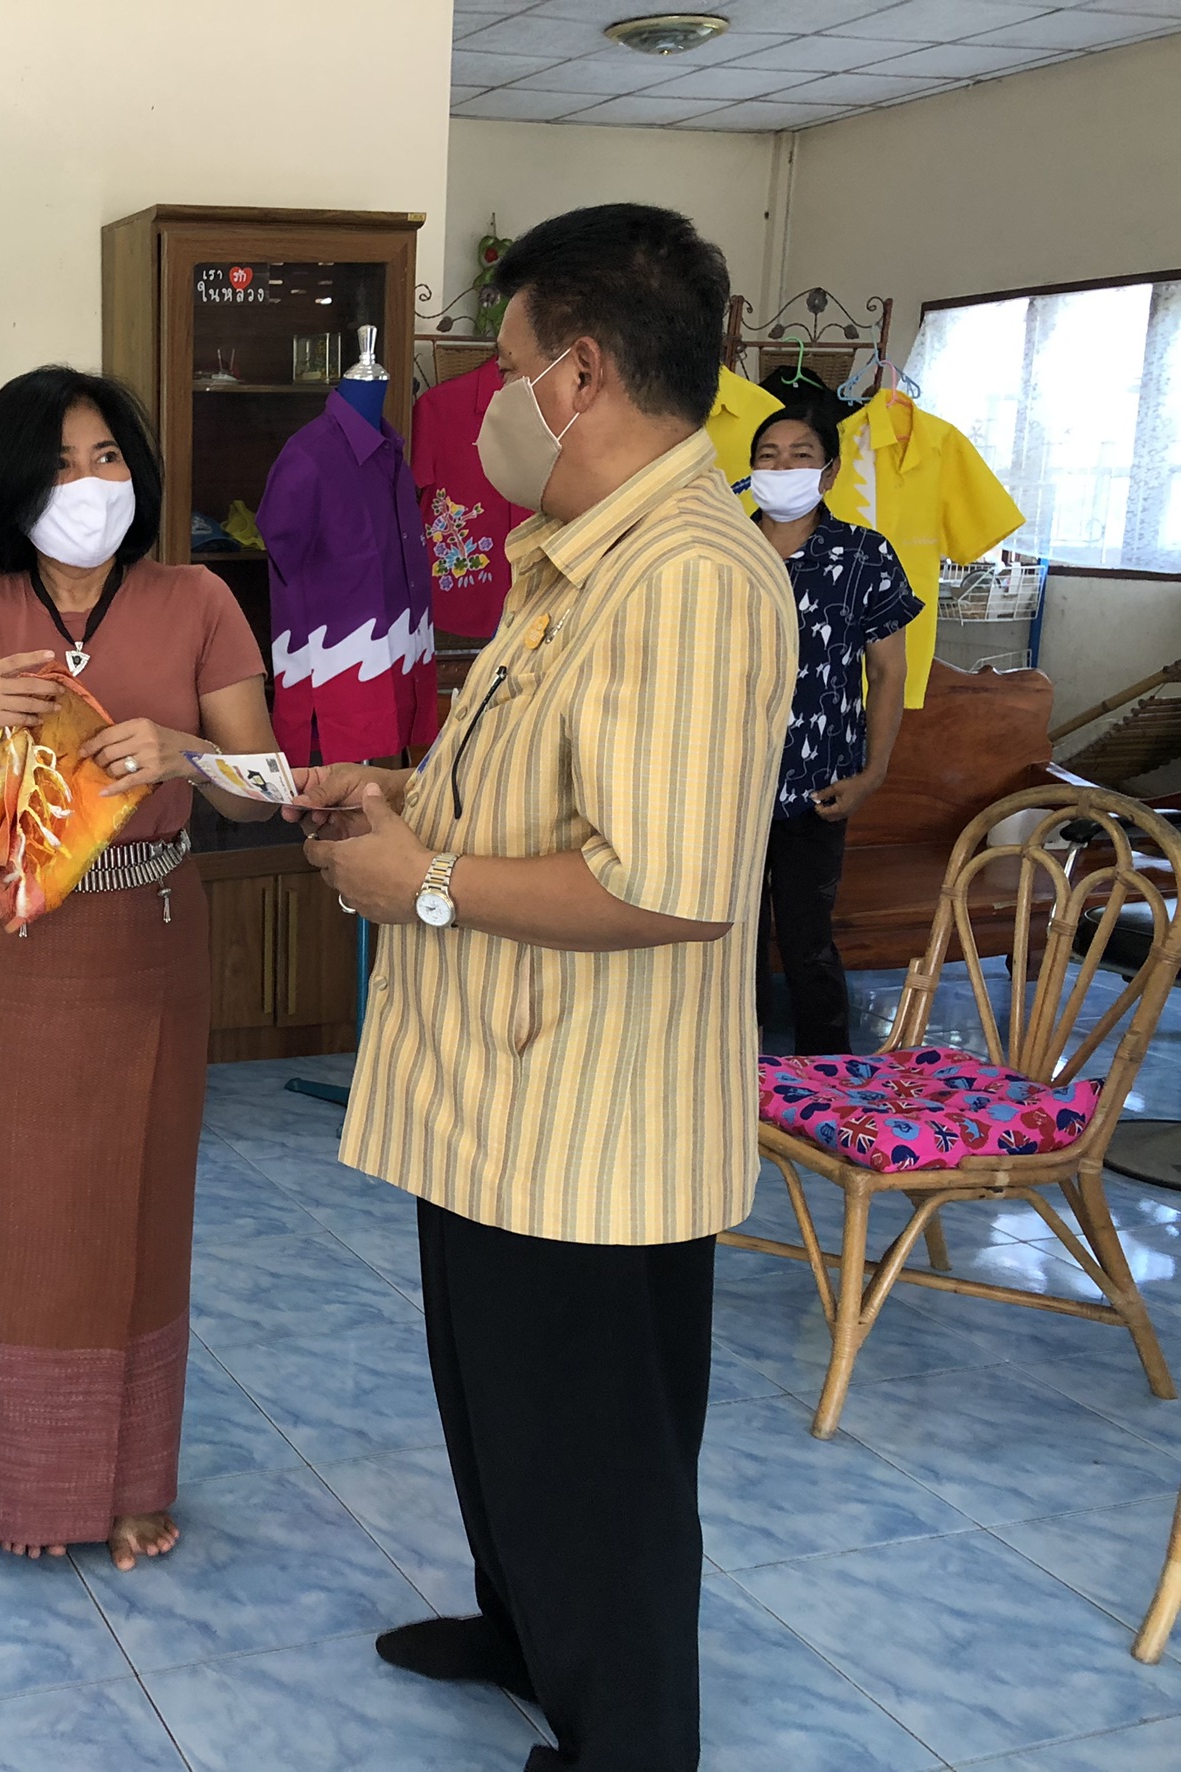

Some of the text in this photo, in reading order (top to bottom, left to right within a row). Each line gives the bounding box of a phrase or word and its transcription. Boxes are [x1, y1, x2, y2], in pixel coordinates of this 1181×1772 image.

[202, 268, 247, 283] เรา รัก
[197, 281, 265, 303] ในหลวง
